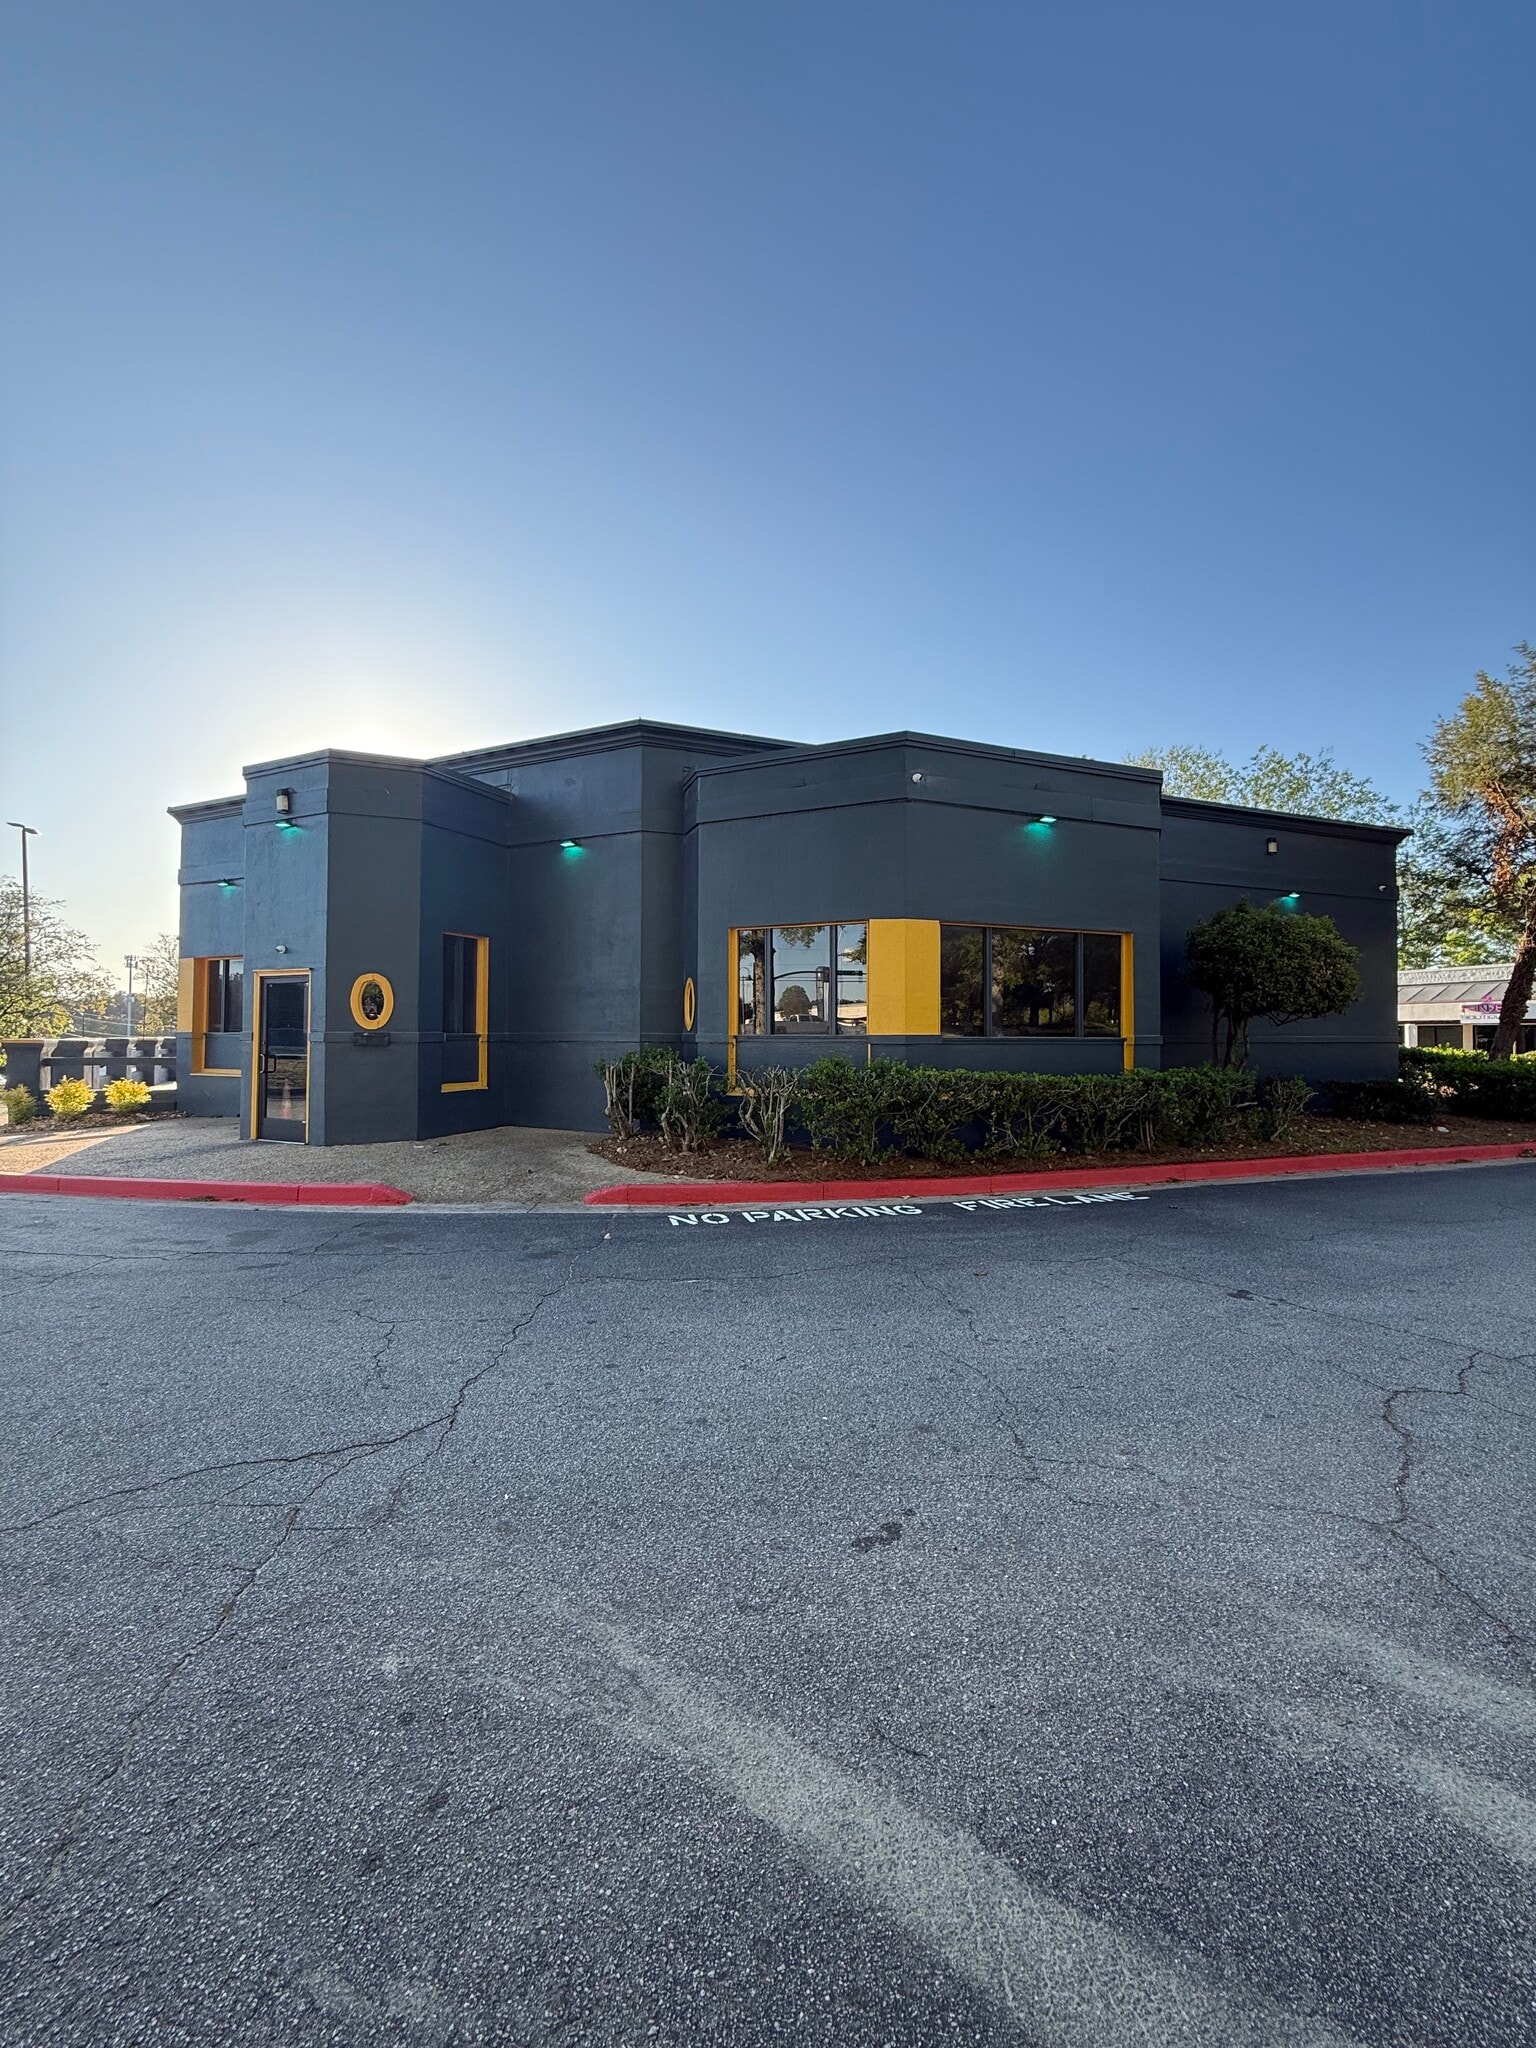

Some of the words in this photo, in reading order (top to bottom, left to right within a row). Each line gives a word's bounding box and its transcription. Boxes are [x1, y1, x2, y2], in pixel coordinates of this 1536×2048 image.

[667, 1213, 730, 1226] NO
[741, 1205, 923, 1223] PARKING
[953, 1197, 1050, 1211] FIRE
[1043, 1191, 1151, 1205] LANE
